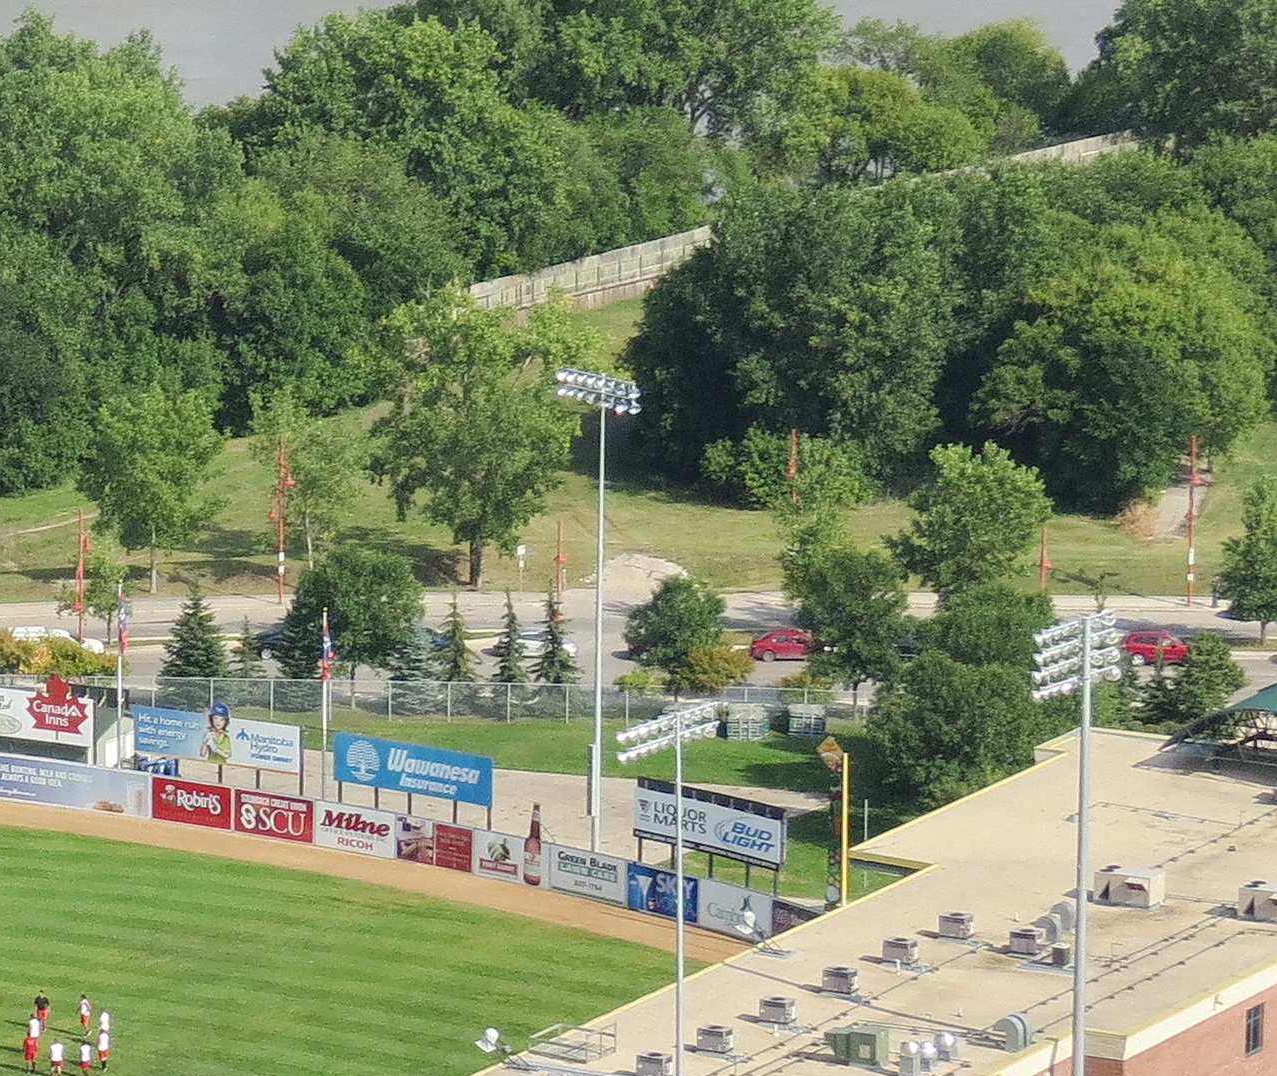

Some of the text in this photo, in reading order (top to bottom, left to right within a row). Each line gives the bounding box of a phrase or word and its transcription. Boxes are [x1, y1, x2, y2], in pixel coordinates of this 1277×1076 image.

[45, 715, 70, 727] Inns
[159, 714, 184, 728] home
[185, 721, 200, 730] run
[138, 725, 188, 741] with energy
[250, 733, 294, 748] Manitoba
[250, 742, 278, 755] Hydro
[387, 748, 480, 784] Wawanesa
[399, 773, 459, 796] Insurance
[258, 807, 307, 836] SCU
[319, 809, 391, 837] Milne
[731, 822, 773, 841] BUD
[337, 836, 374, 851] RICOH
[722, 831, 775, 853] LIGHT
